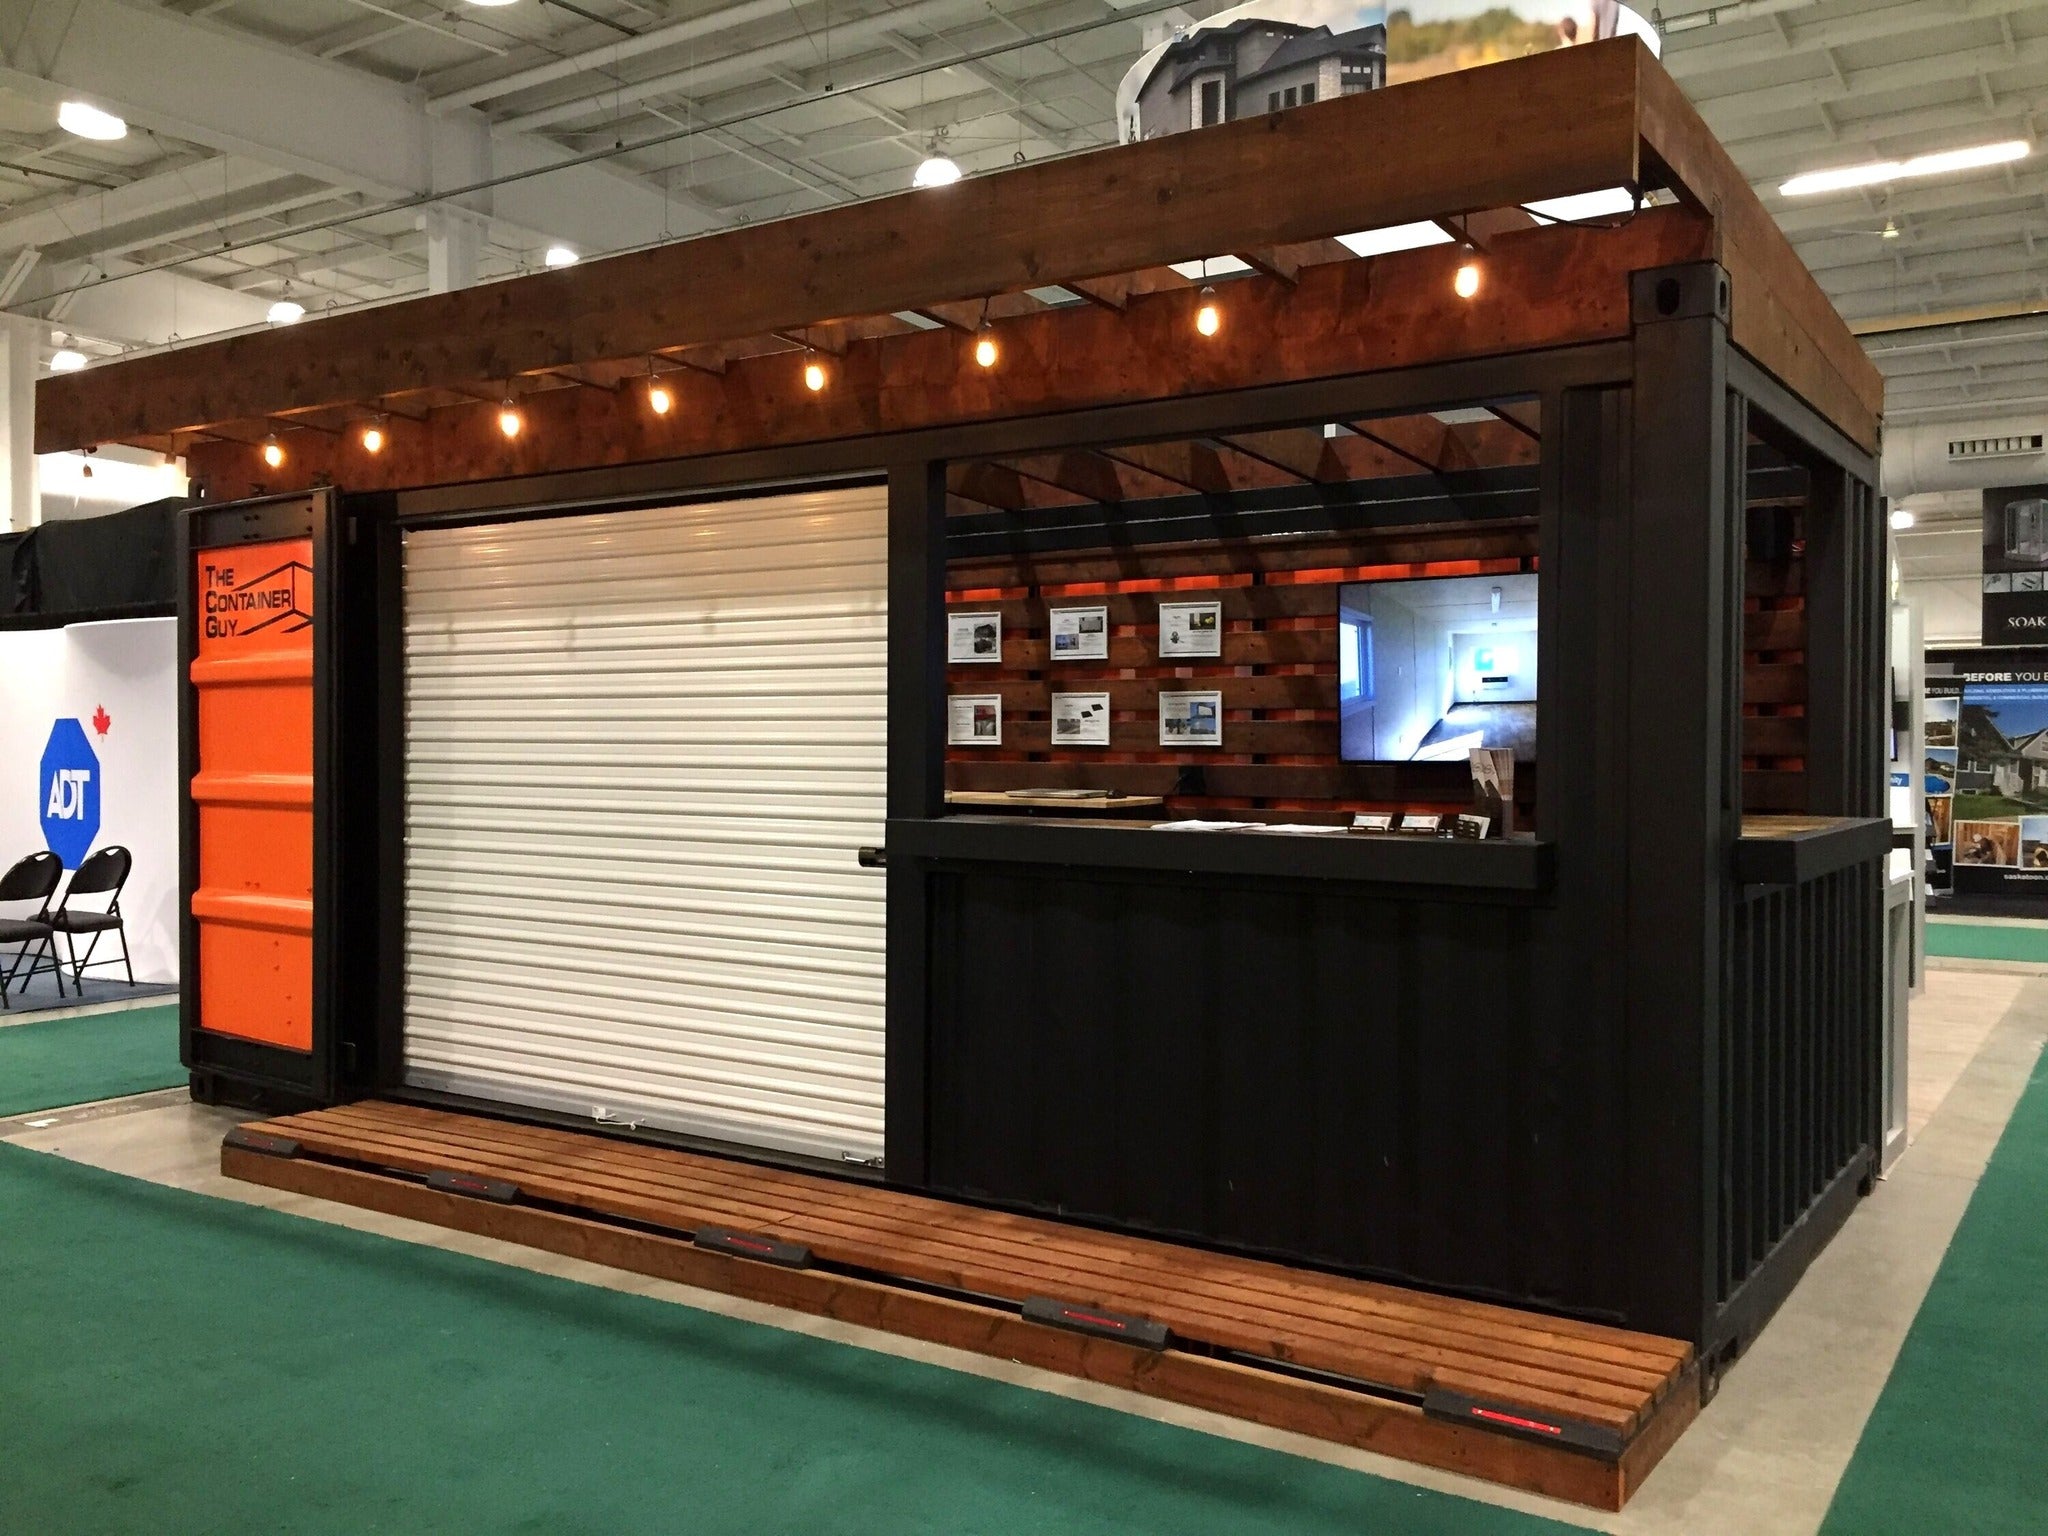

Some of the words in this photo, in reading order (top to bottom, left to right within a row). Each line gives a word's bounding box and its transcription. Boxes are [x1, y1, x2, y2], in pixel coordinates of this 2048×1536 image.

[206, 589, 291, 613] CONTAINER
[2015, 672, 2041, 682] YOU
[46, 768, 91, 821] ADT
